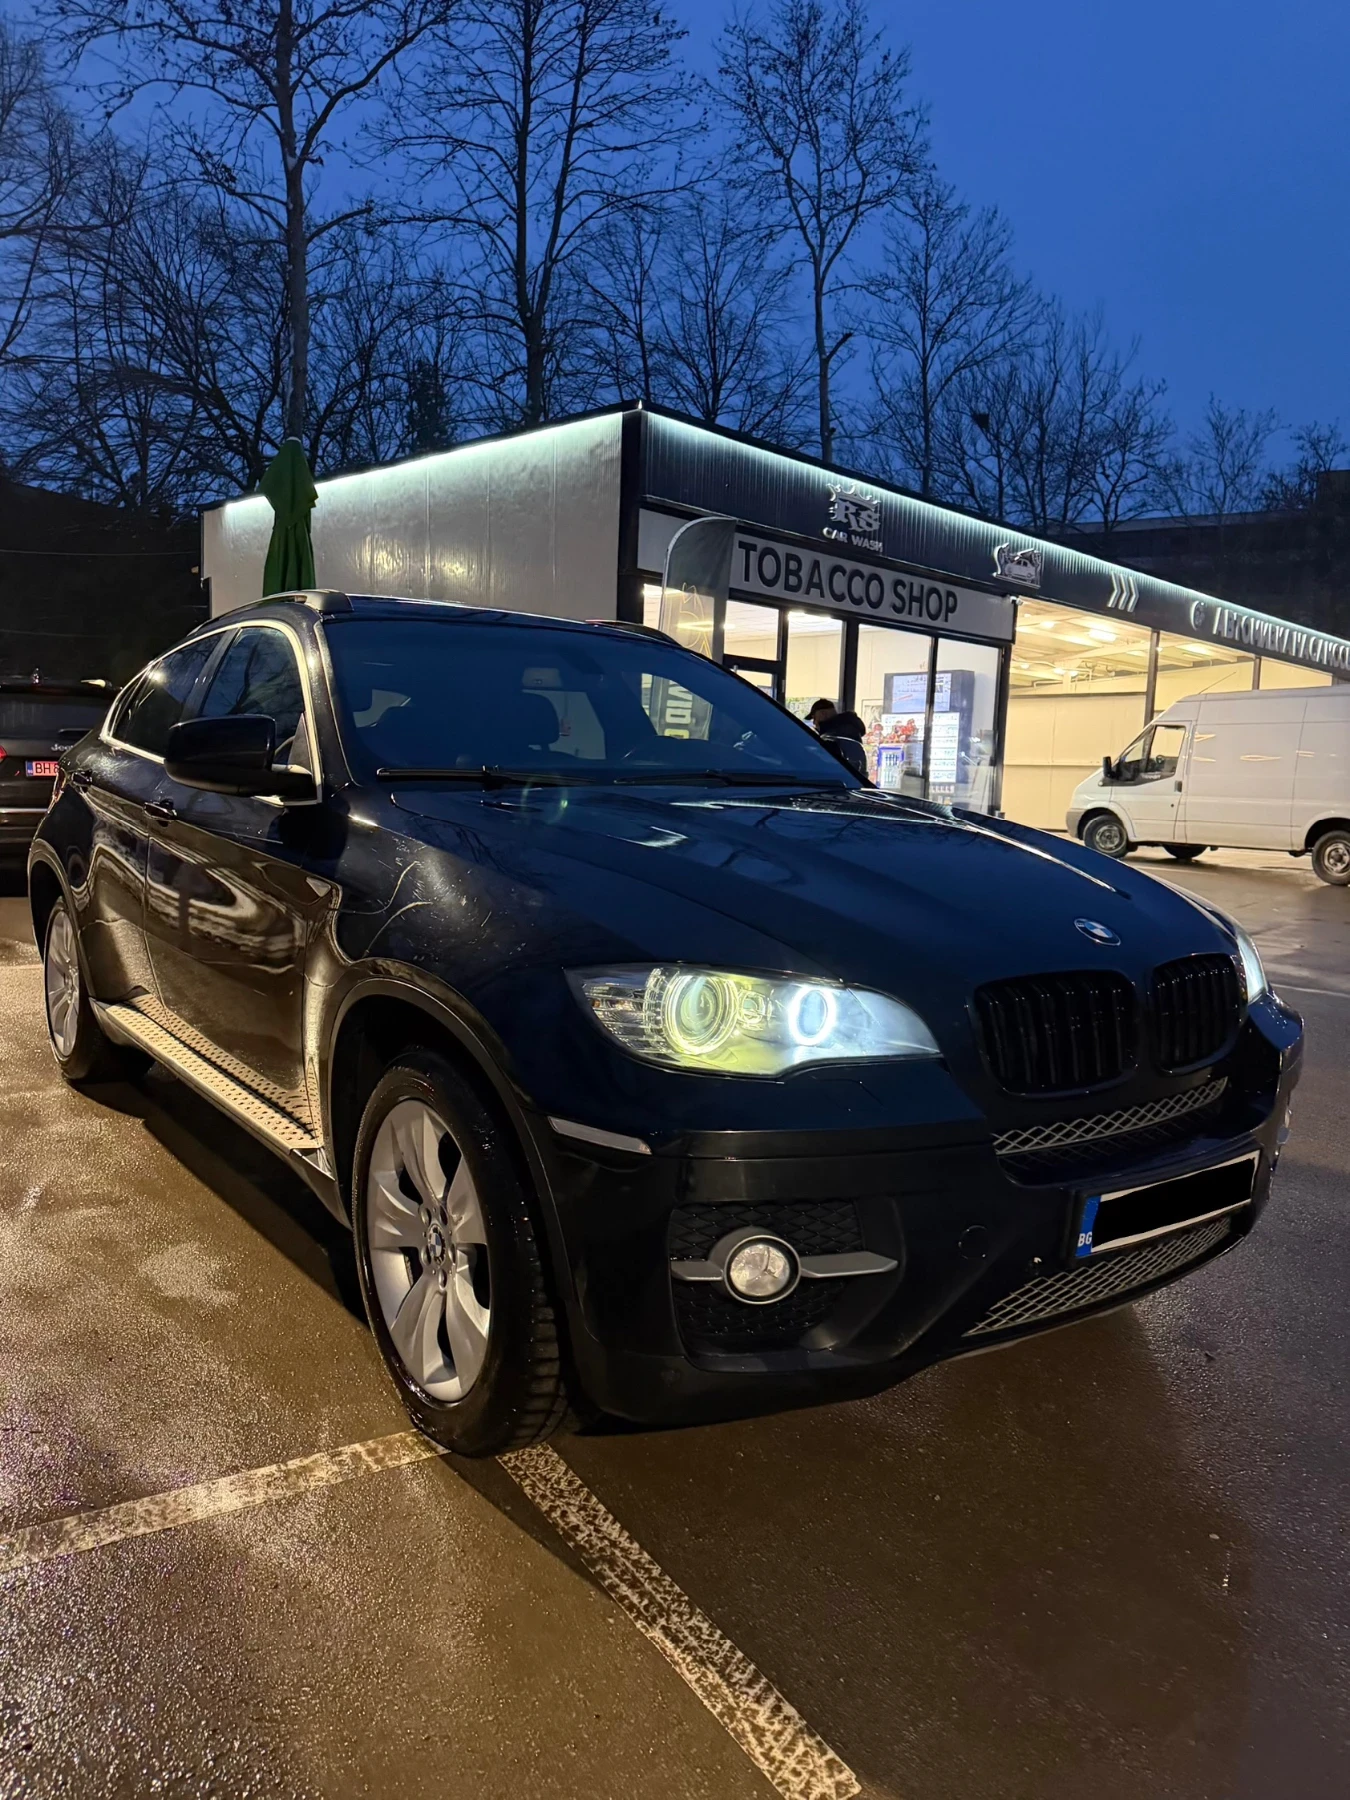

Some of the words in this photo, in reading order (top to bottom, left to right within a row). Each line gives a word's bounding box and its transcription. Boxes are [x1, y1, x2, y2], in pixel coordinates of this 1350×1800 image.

[822, 527, 848, 543] CAR
[851, 535, 883, 553] WASH
[738, 540, 884, 609] TOBACCO
[890, 578, 958, 623] SHOP
[35, 762, 50, 774] BH
[1077, 1231, 1093, 1247] BG
